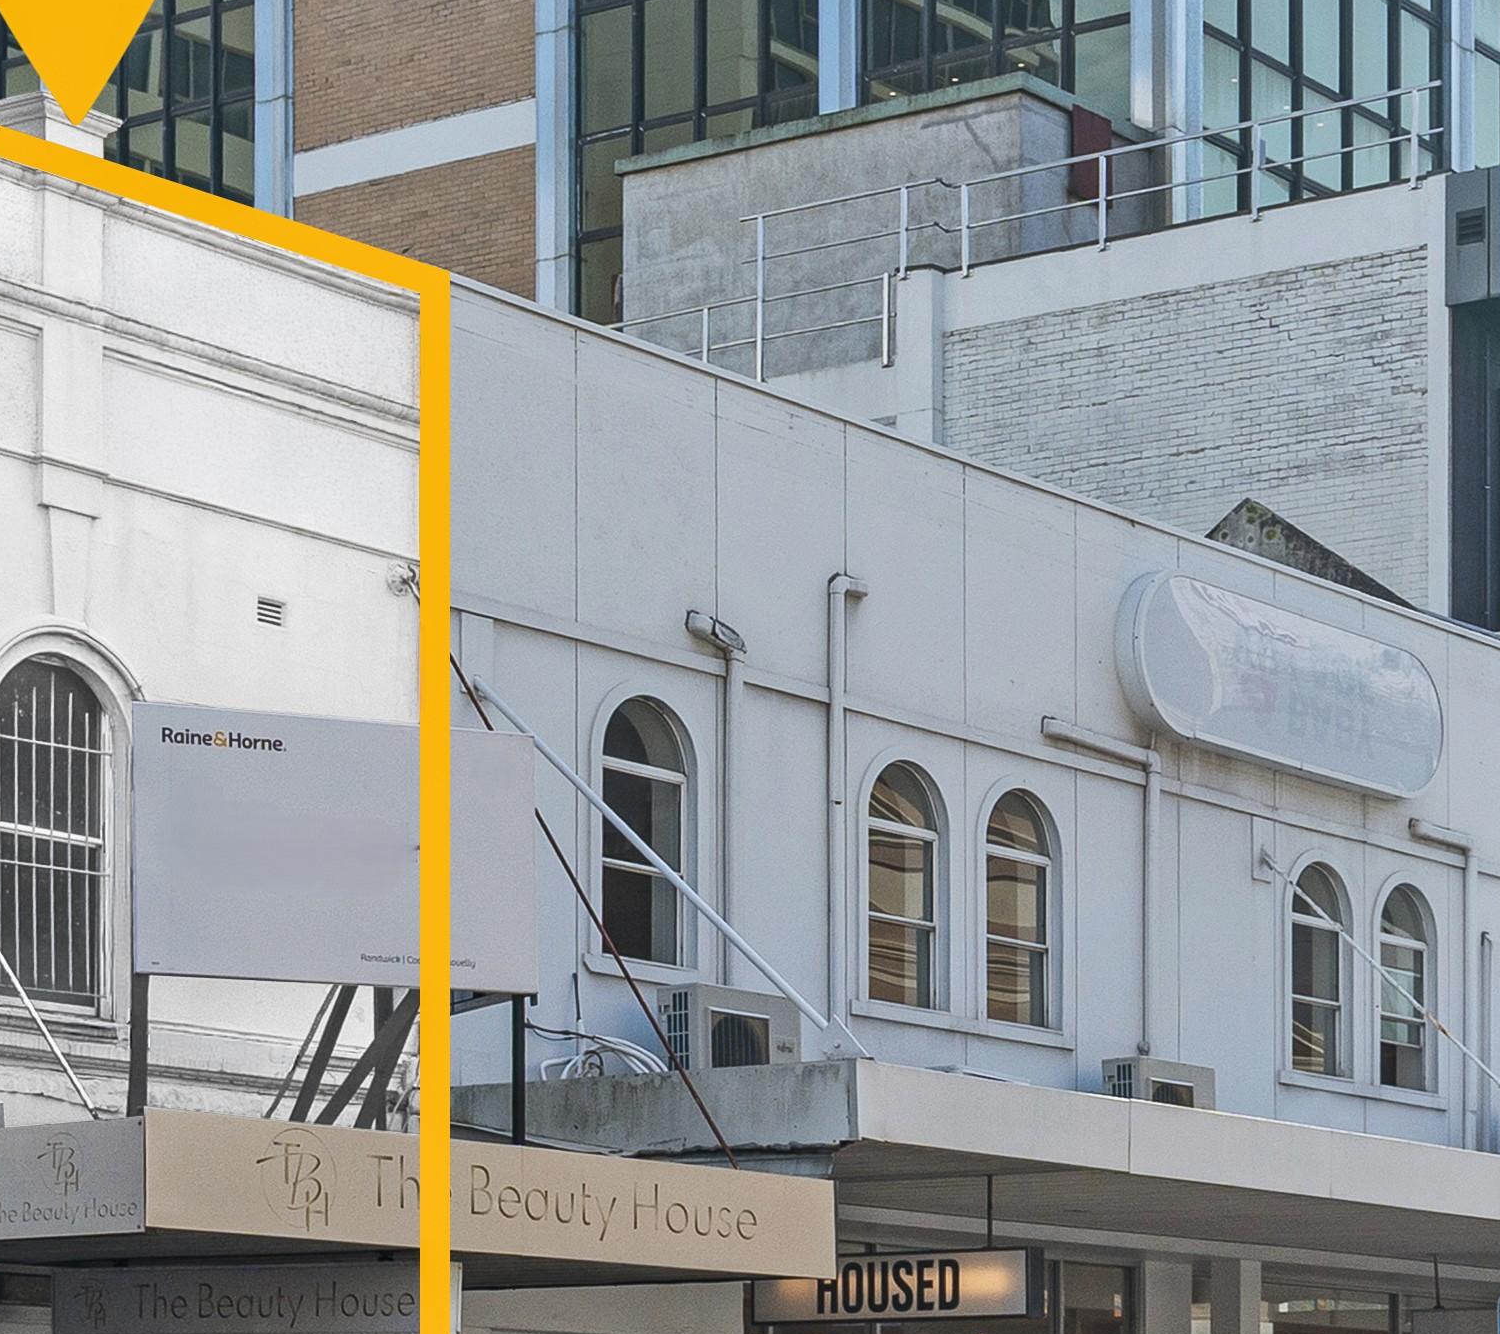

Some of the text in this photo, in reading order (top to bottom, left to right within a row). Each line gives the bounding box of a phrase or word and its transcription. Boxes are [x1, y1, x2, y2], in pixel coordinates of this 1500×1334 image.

[450, 958, 477, 969] ovelly
[23, 1200, 80, 1226] Beauty
[85, 1197, 138, 1220] House
[366, 1153, 758, 1243] Th Beauty House
[131, 1280, 416, 1328] The Beauty House
[816, 1258, 960, 1315] HOUSED
